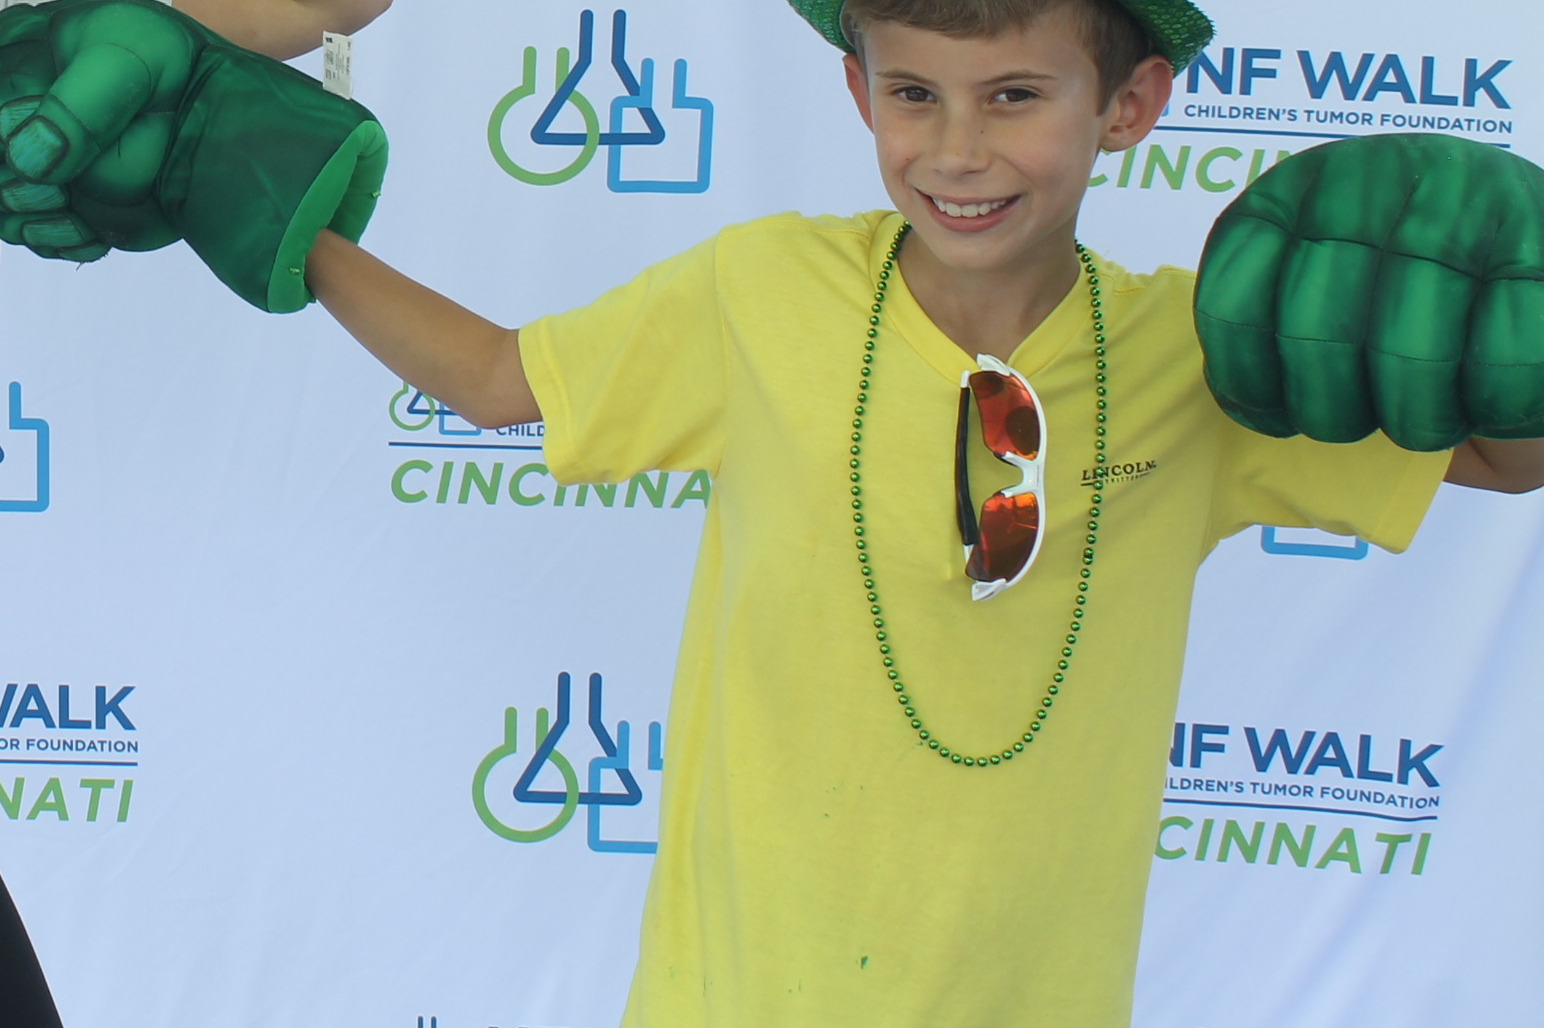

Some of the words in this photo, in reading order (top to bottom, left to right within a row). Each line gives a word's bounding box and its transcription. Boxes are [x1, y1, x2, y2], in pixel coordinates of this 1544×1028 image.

[1186, 47, 1281, 95] NF
[1296, 50, 1512, 109] WALK
[1185, 105, 1297, 121] CHILDREN'S
[1304, 110, 1373, 125] TUMOR
[1380, 114, 1512, 133] FOUNDATION
[27, 739, 138, 753] FOUNDATION
[1243, 727, 1444, 787] WALK
[1250, 782, 1314, 797] TUMOR
[1320, 786, 1440, 808] FOUNDATION
